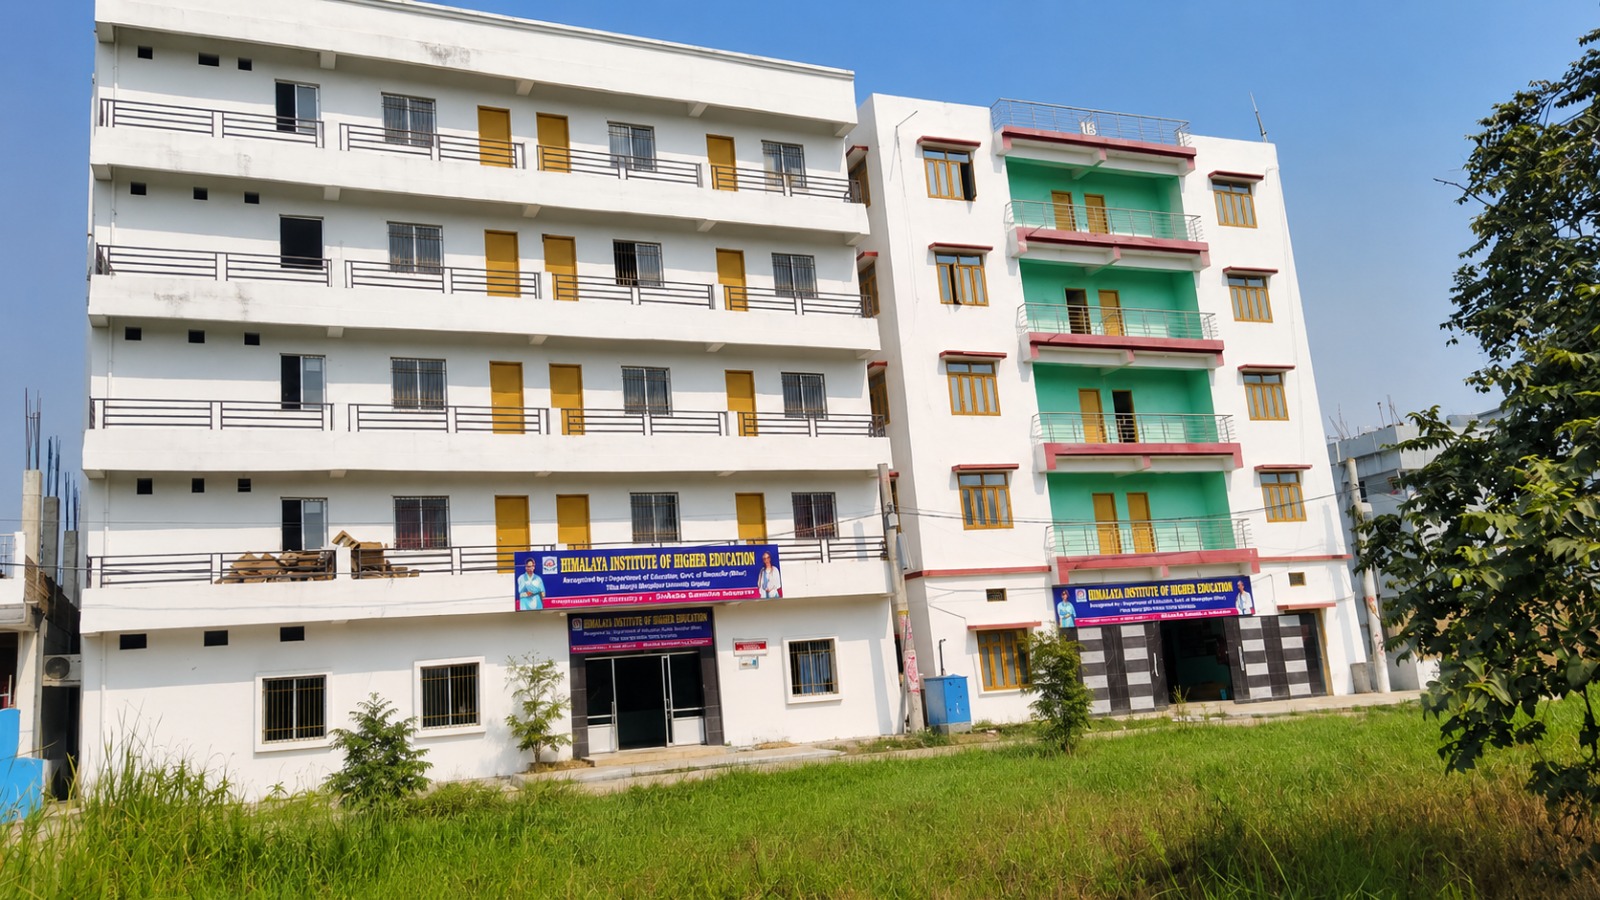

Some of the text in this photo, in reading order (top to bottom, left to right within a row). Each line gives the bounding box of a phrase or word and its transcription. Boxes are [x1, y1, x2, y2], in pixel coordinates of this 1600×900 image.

[560, 551, 755, 573] HIMALAYA INSTITUTE OF HIGHER EDUCATION
[1088, 581, 1234, 601] HIMALAYA INSTITUTE OF HIGHER EDUCATION
[644, 615, 652, 625] OF
